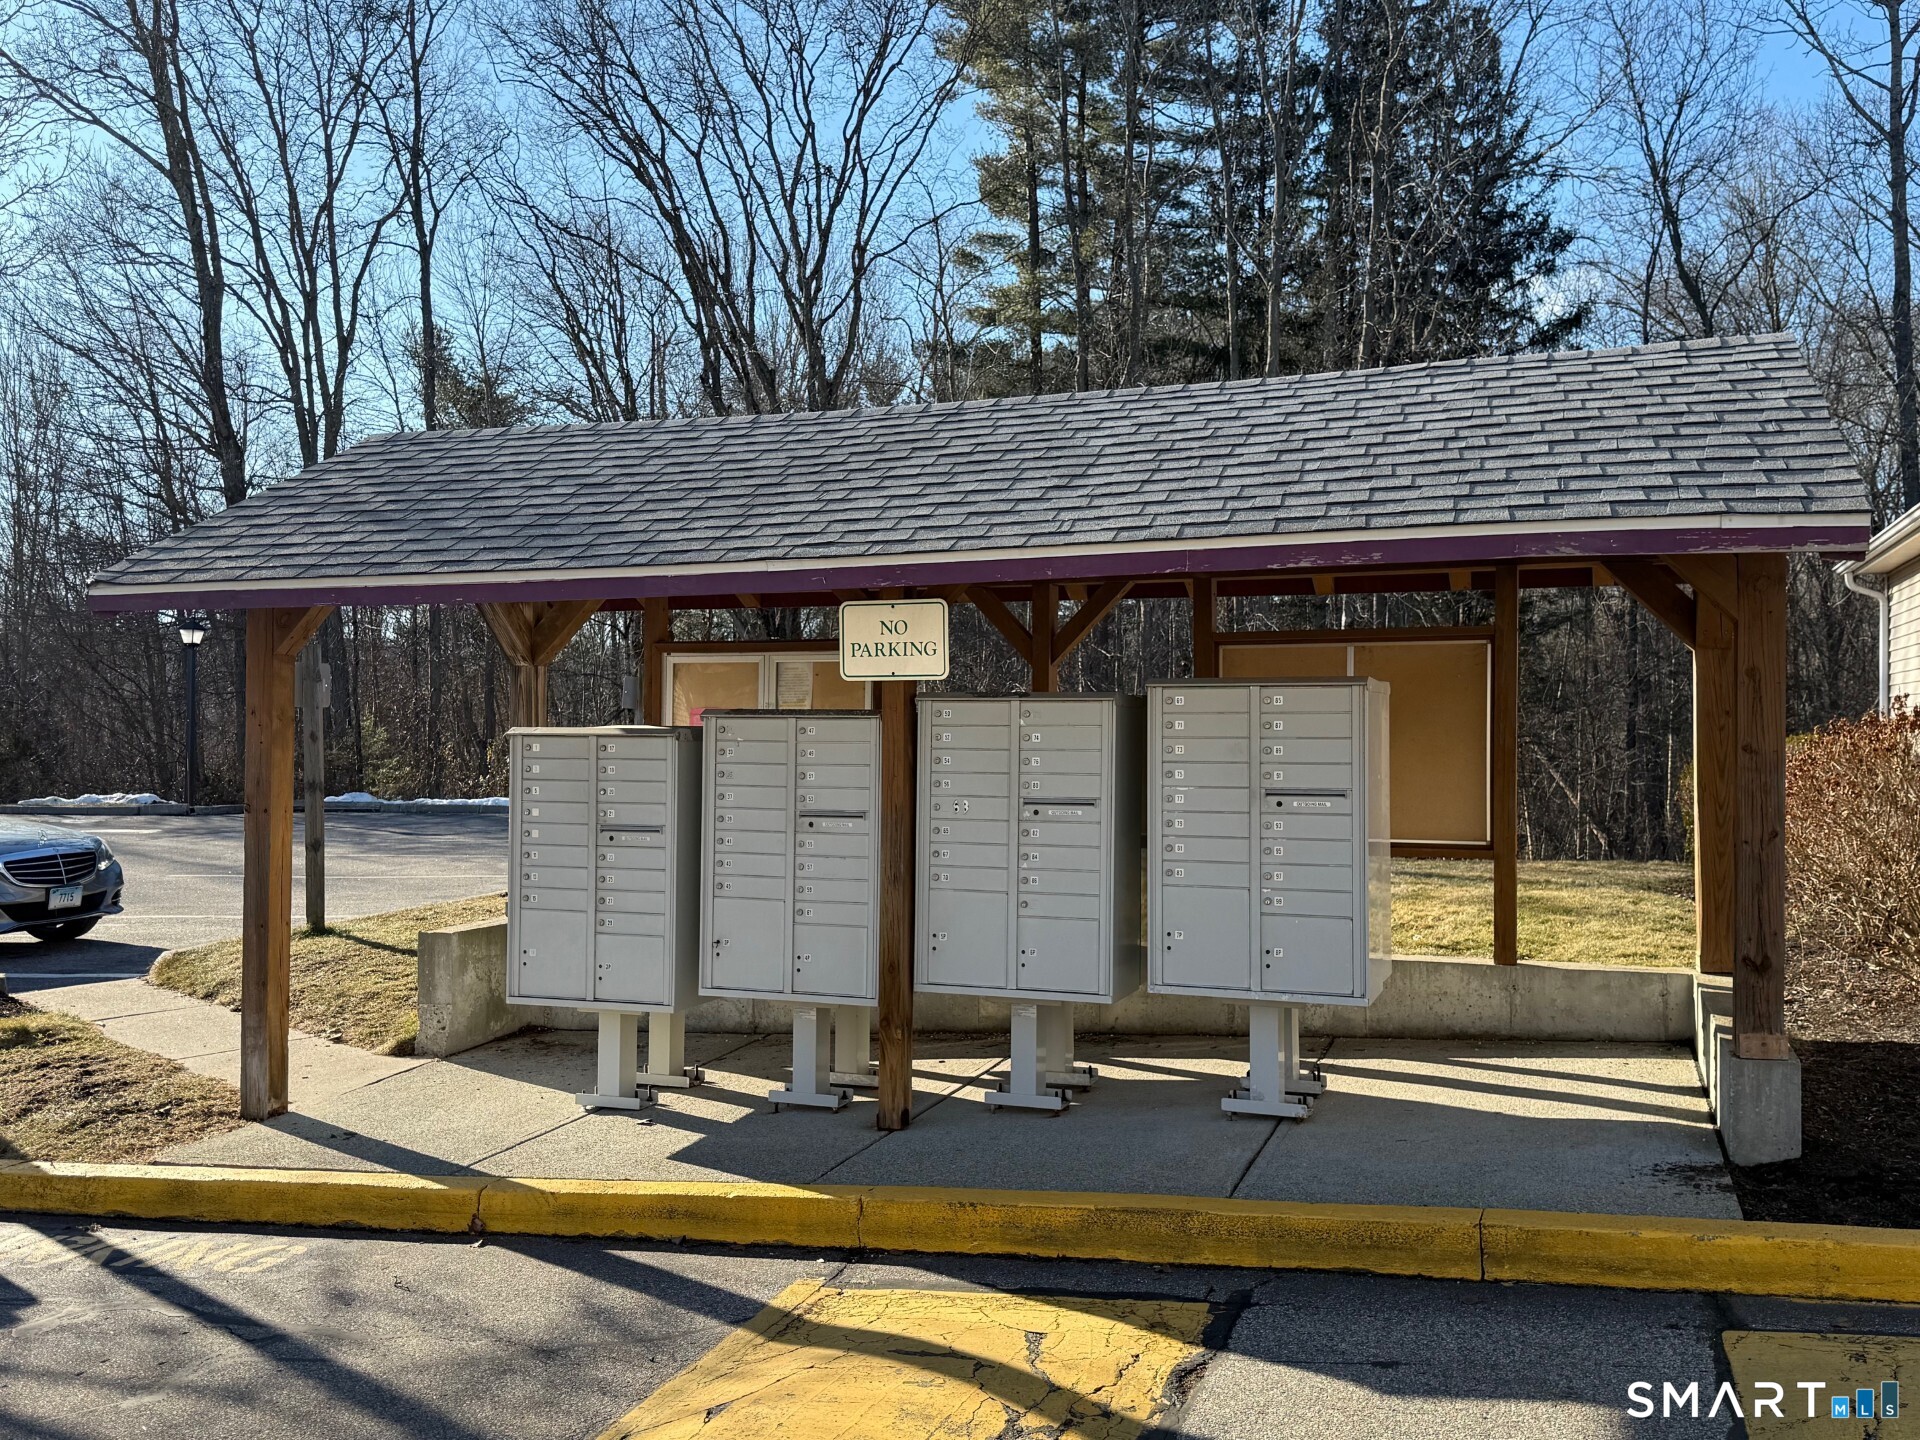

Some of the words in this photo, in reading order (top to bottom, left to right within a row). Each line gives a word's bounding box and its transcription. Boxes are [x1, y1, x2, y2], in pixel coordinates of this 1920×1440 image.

[879, 620, 908, 635] NO
[850, 641, 938, 657] PARKING
[59, 892, 74, 903] 7715
